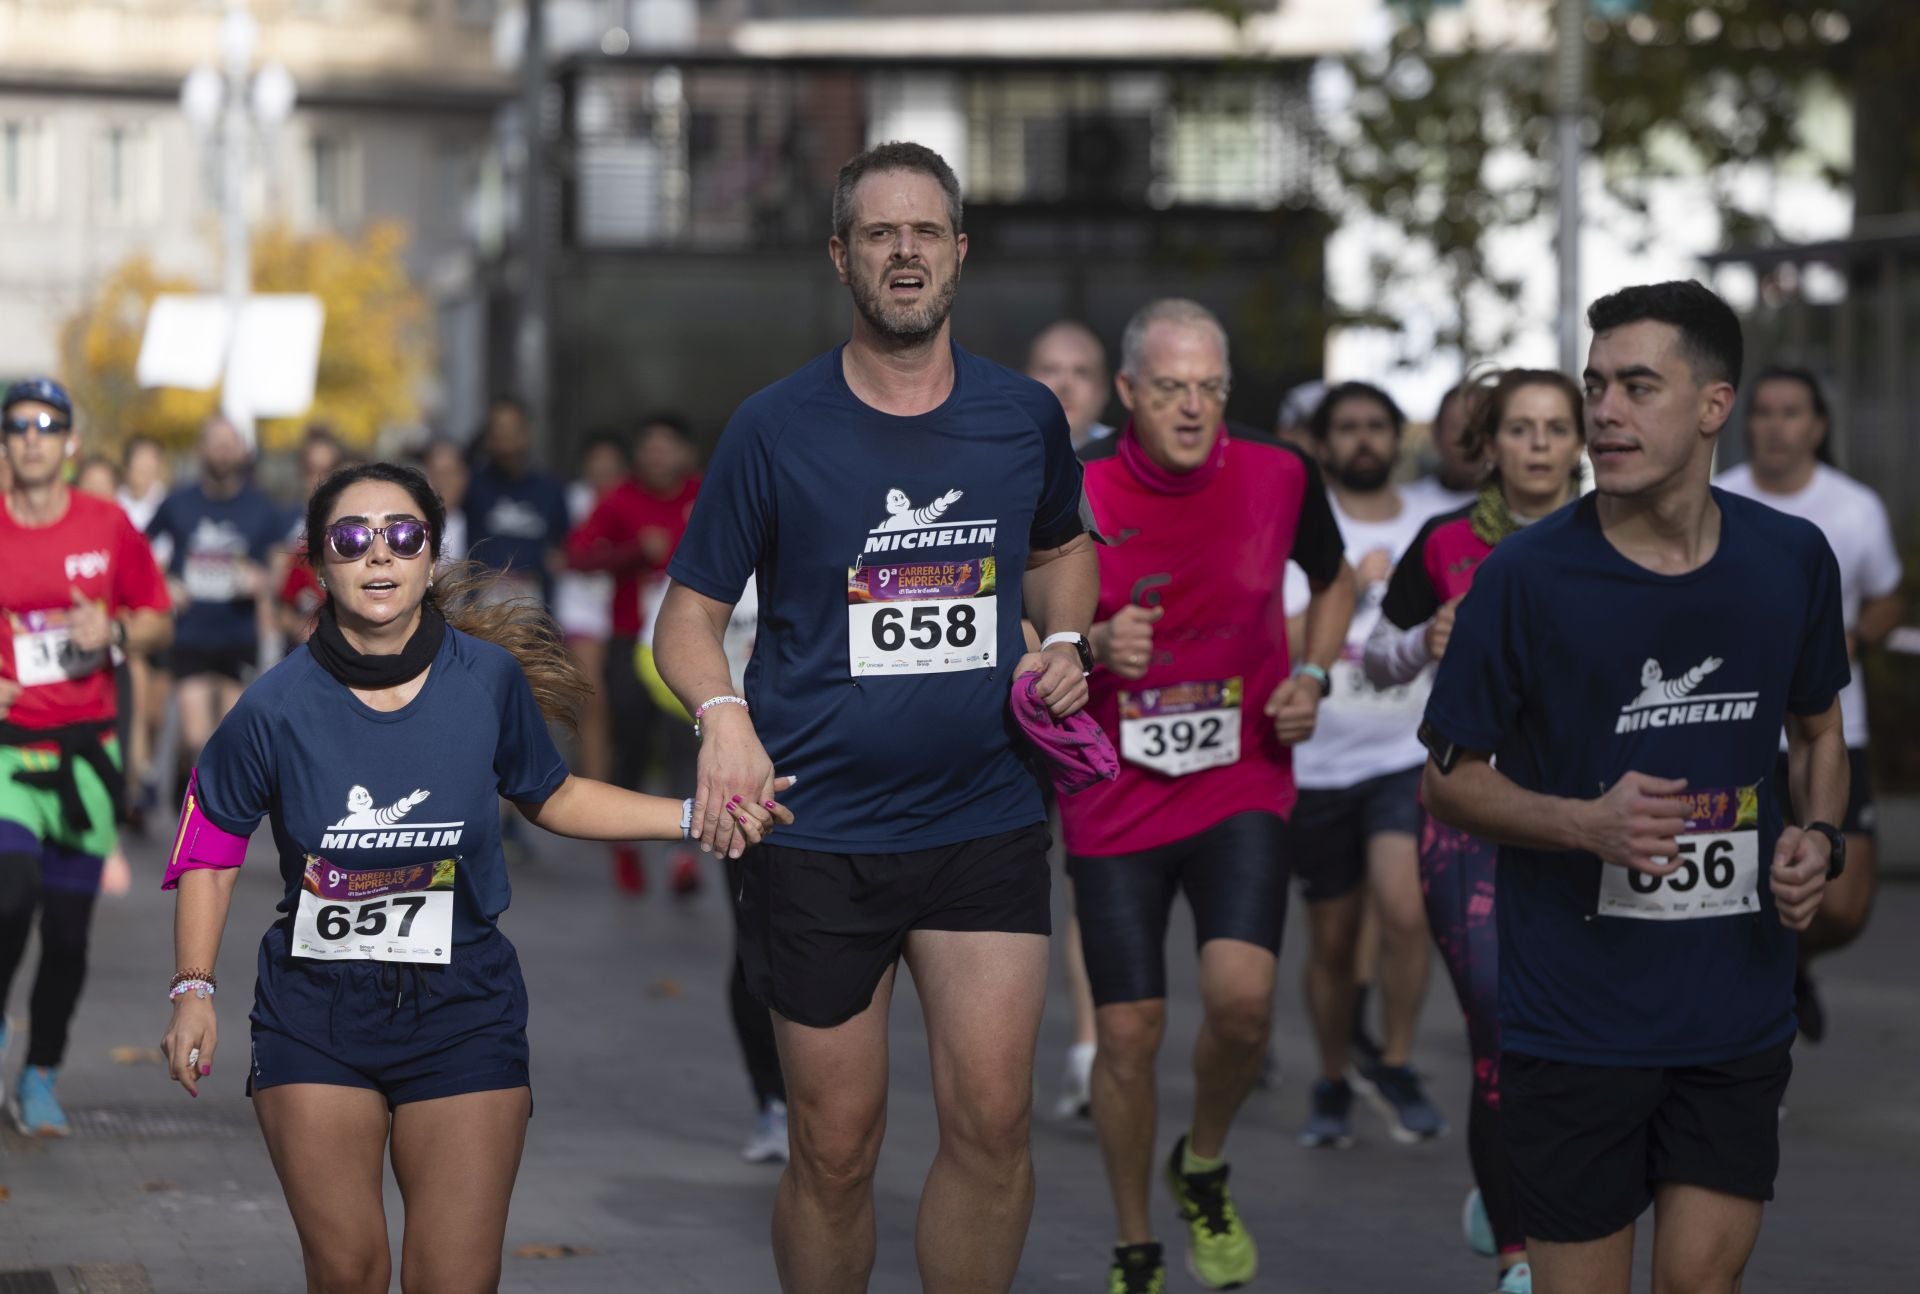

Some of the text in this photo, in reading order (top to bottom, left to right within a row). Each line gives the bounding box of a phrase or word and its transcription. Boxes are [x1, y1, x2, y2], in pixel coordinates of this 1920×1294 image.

[864, 528, 997, 553] MICHELIN
[898, 575, 954, 588] EMPRESAS
[899, 566, 941, 577] CARRERA
[943, 565, 955, 575] DE
[871, 604, 977, 651] 658
[1614, 701, 1758, 734] MICHELIN
[1142, 717, 1222, 757] 392
[320, 829, 463, 849] MICHELIN
[348, 870, 392, 882] CARRERA
[394, 869, 406, 878] DE
[348, 876, 406, 891] EMPRESAS
[315, 896, 427, 941] 657
